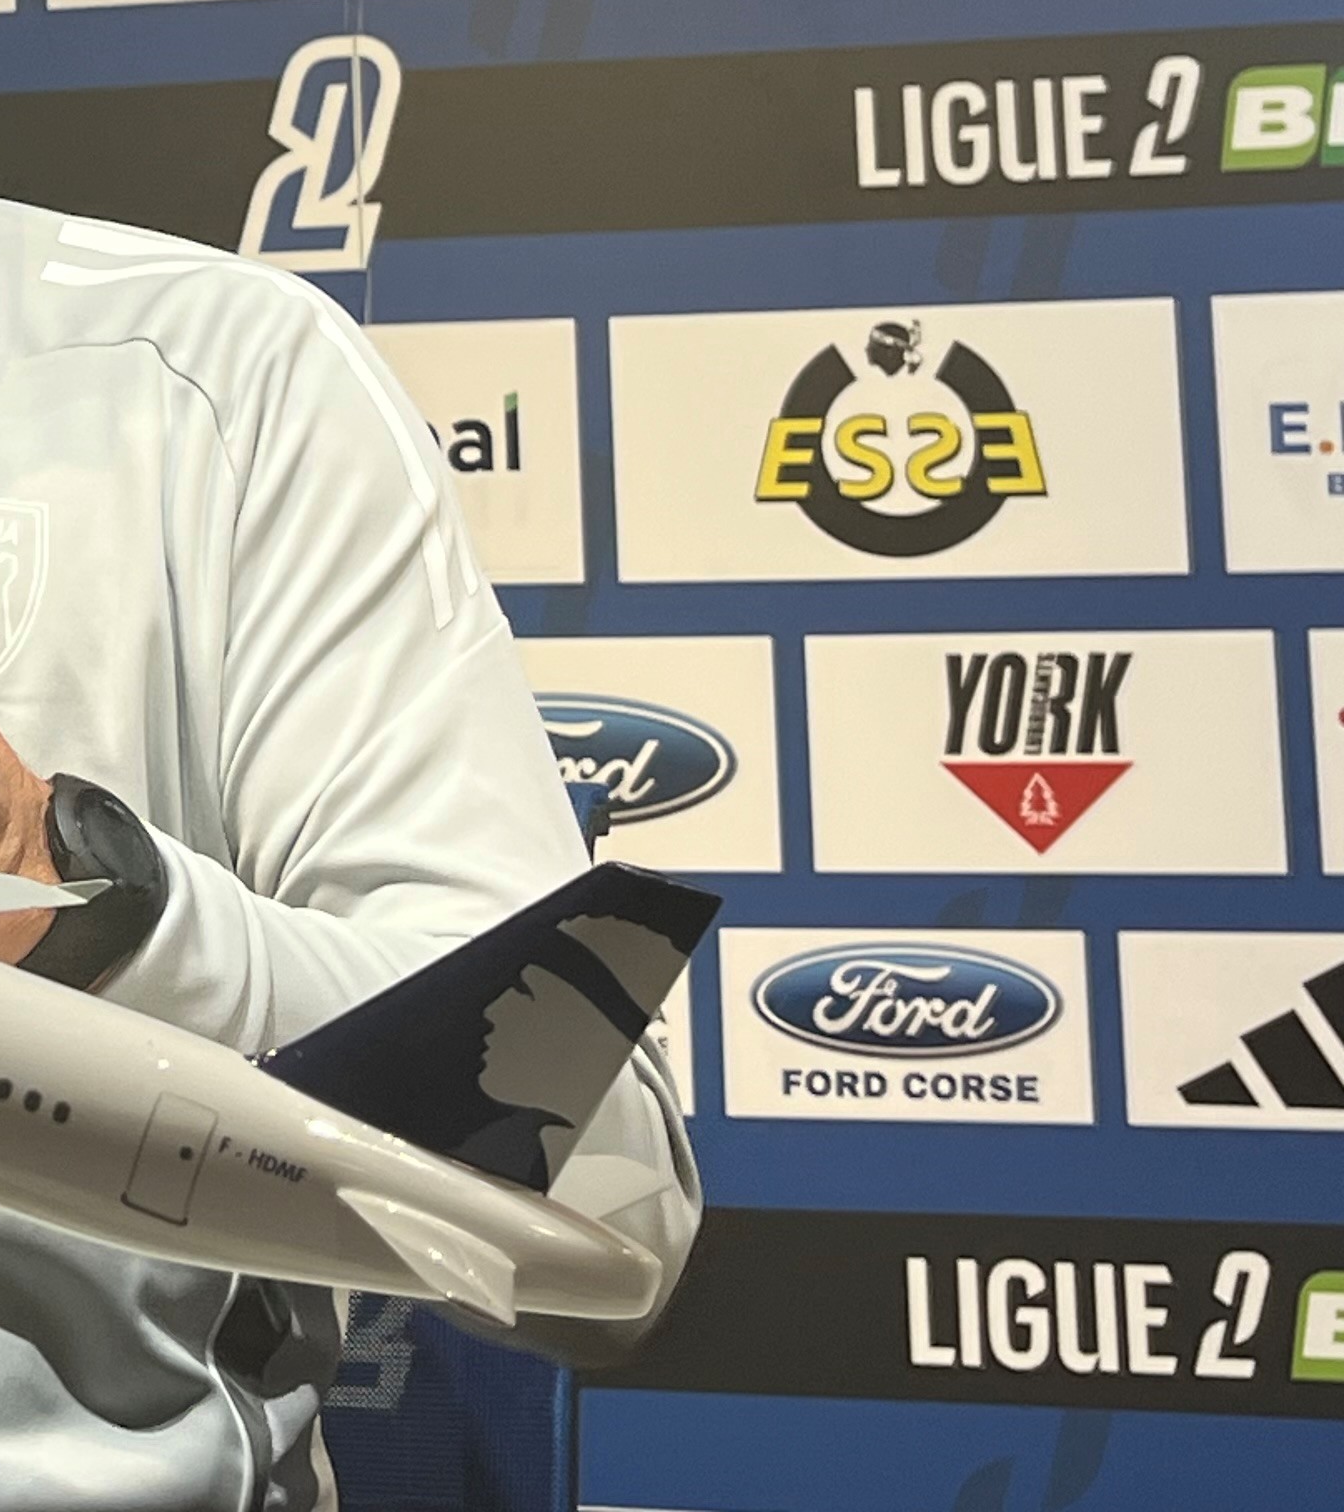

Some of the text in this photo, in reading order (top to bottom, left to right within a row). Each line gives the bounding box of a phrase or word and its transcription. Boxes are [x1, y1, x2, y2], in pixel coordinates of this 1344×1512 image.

[854, 75, 1114, 188] LIGUE
[1129, 55, 1201, 176] 2
[944, 651, 1133, 756] YORK
[811, 956, 1004, 1041] Ford
[781, 1069, 1041, 1104] FORD CORSE
[905, 1256, 1179, 1375] LIGUE
[1194, 1251, 1271, 1379] 2
